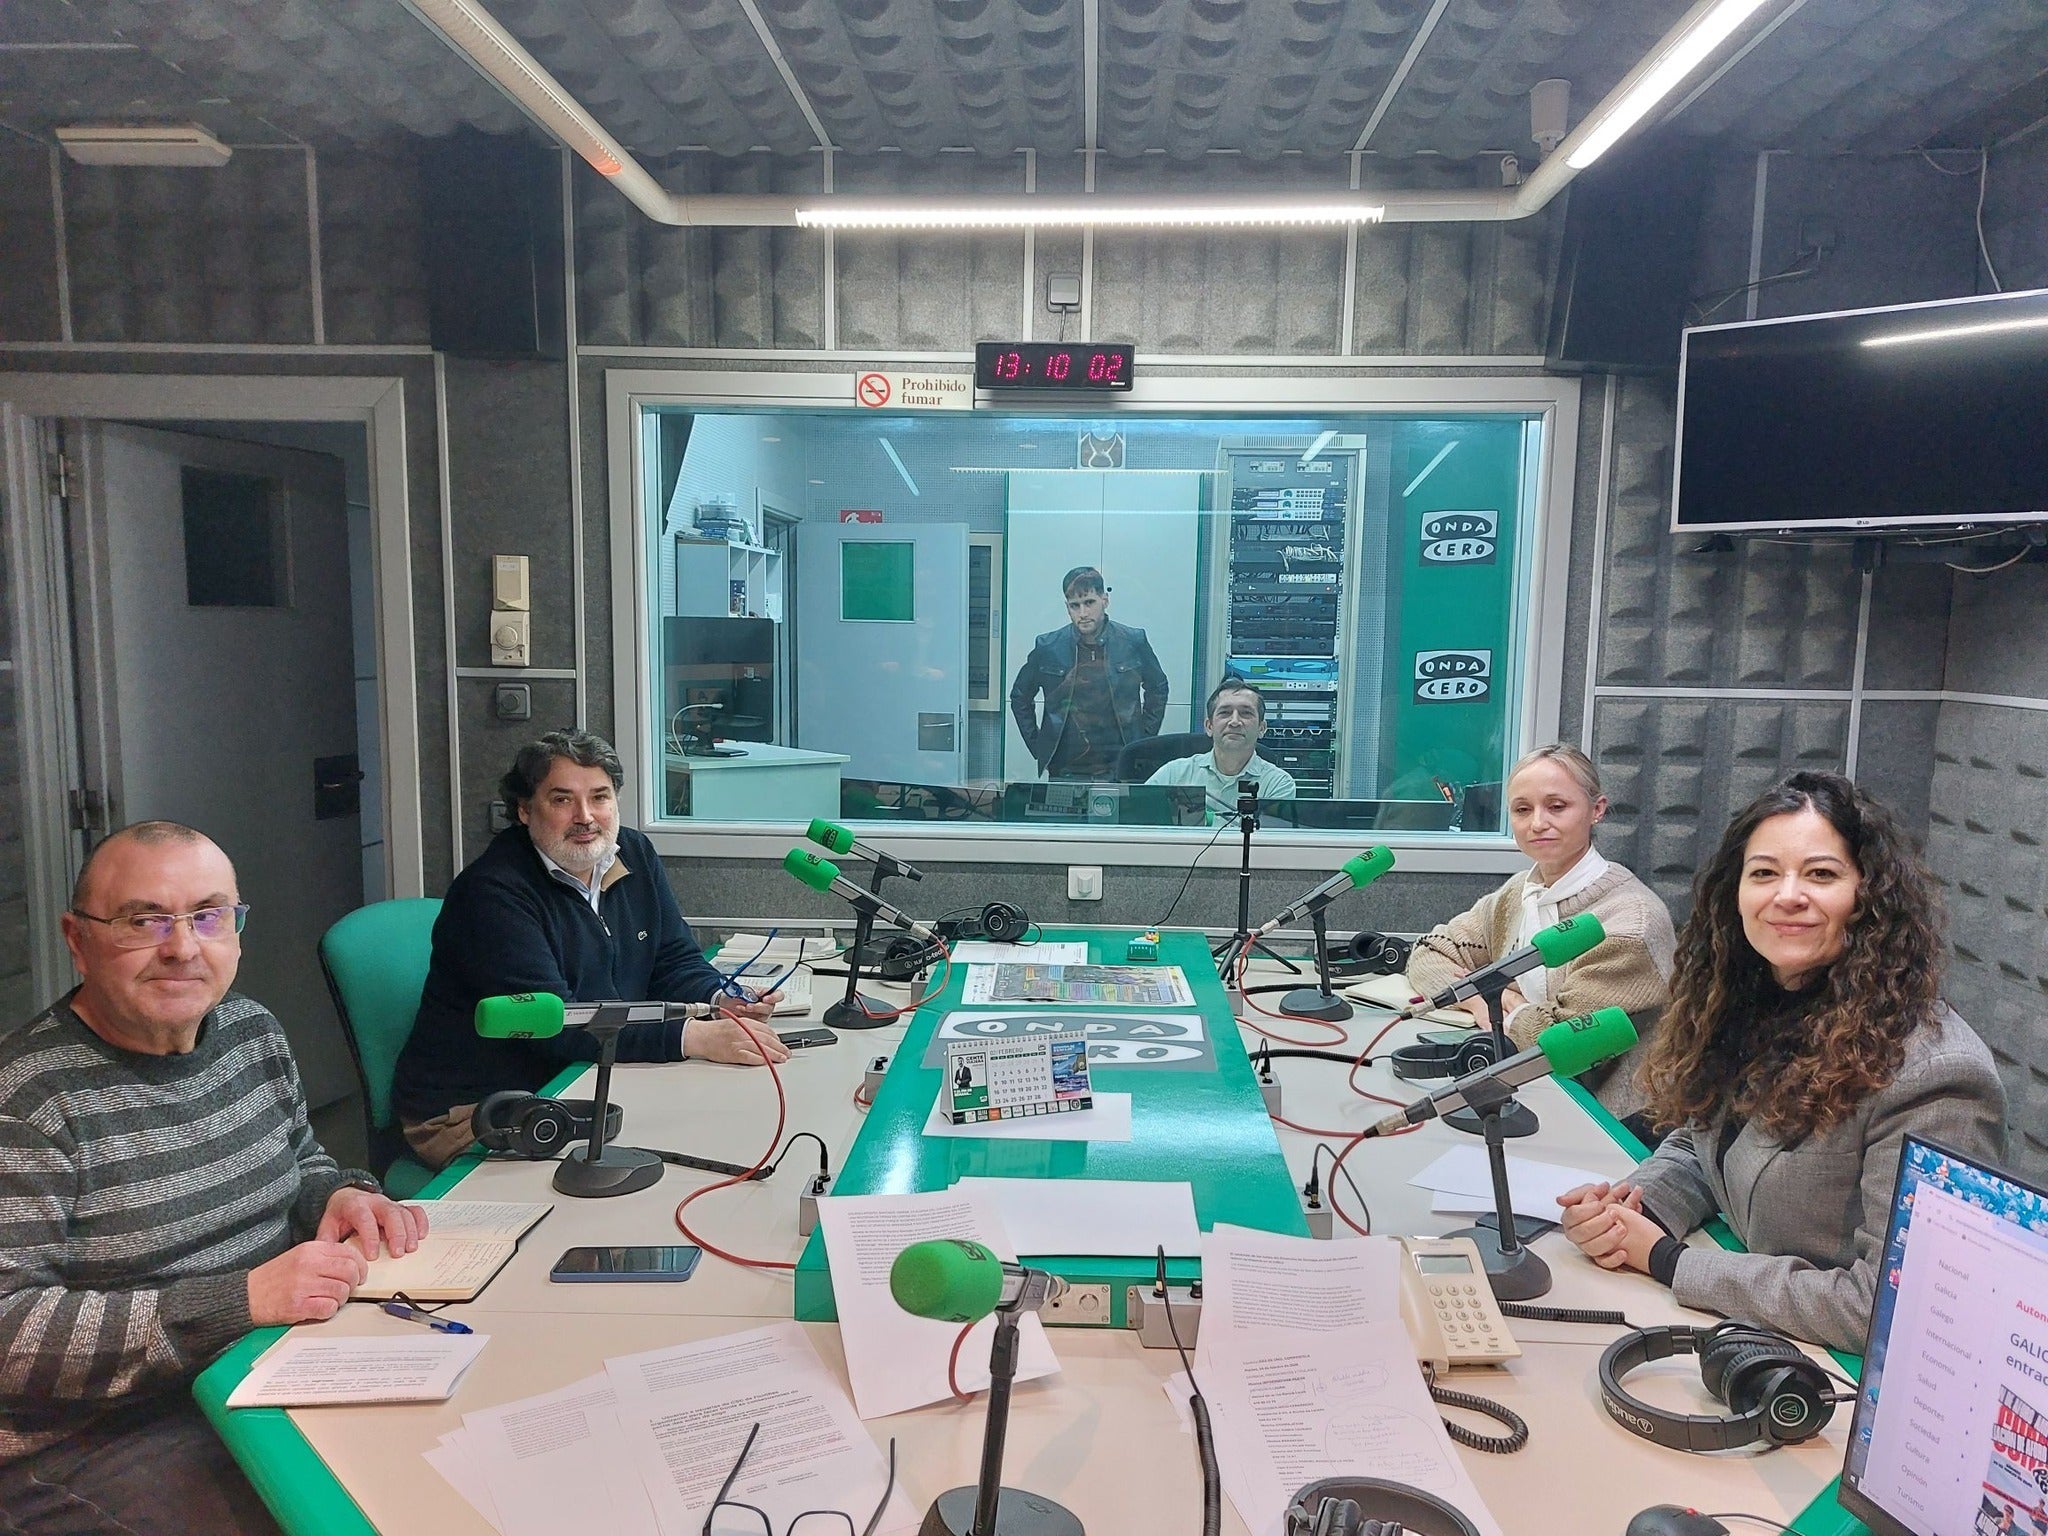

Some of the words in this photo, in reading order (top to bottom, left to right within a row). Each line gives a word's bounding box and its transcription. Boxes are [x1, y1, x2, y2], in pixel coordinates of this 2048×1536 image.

[1088, 353, 1124, 380] 02
[902, 378, 966, 392] Prohibido
[902, 392, 942, 406] fumar
[1431, 521, 1486, 534] ONDA
[1433, 543, 1485, 556] CERO
[1425, 661, 1479, 673] ONDA
[1427, 682, 1479, 695] CERO
[977, 1022, 1165, 1036] ONDA
[1938, 1259, 1970, 1281] Nacional
[1934, 1282, 1957, 1300] Galicia
[1930, 1305, 1954, 1324] Galego
[1925, 1328, 1972, 1360] Internacional
[1917, 1373, 1937, 1391] Salud
[1913, 1396, 1944, 1421] Deportes
[1909, 1418, 1940, 1445] Sociedad
[1905, 1441, 1930, 1464] Cultura
[1897, 1486, 1925, 1511] Turismo
